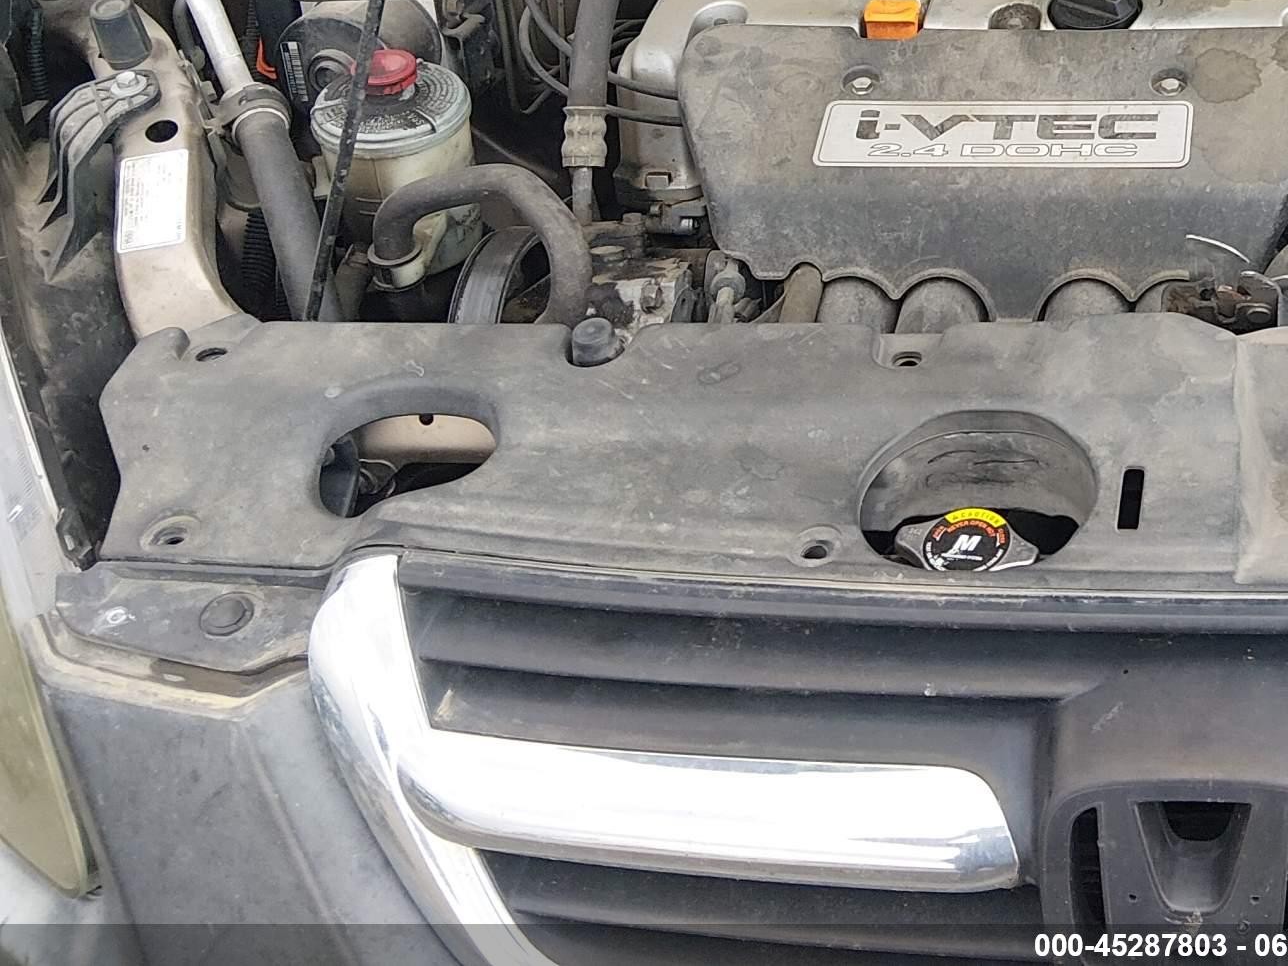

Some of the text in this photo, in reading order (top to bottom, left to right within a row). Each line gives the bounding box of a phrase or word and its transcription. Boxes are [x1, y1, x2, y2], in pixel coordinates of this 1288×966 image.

[856, 109, 1159, 141] i-VTEC
[868, 143, 1138, 157] 2.4 DOHC
